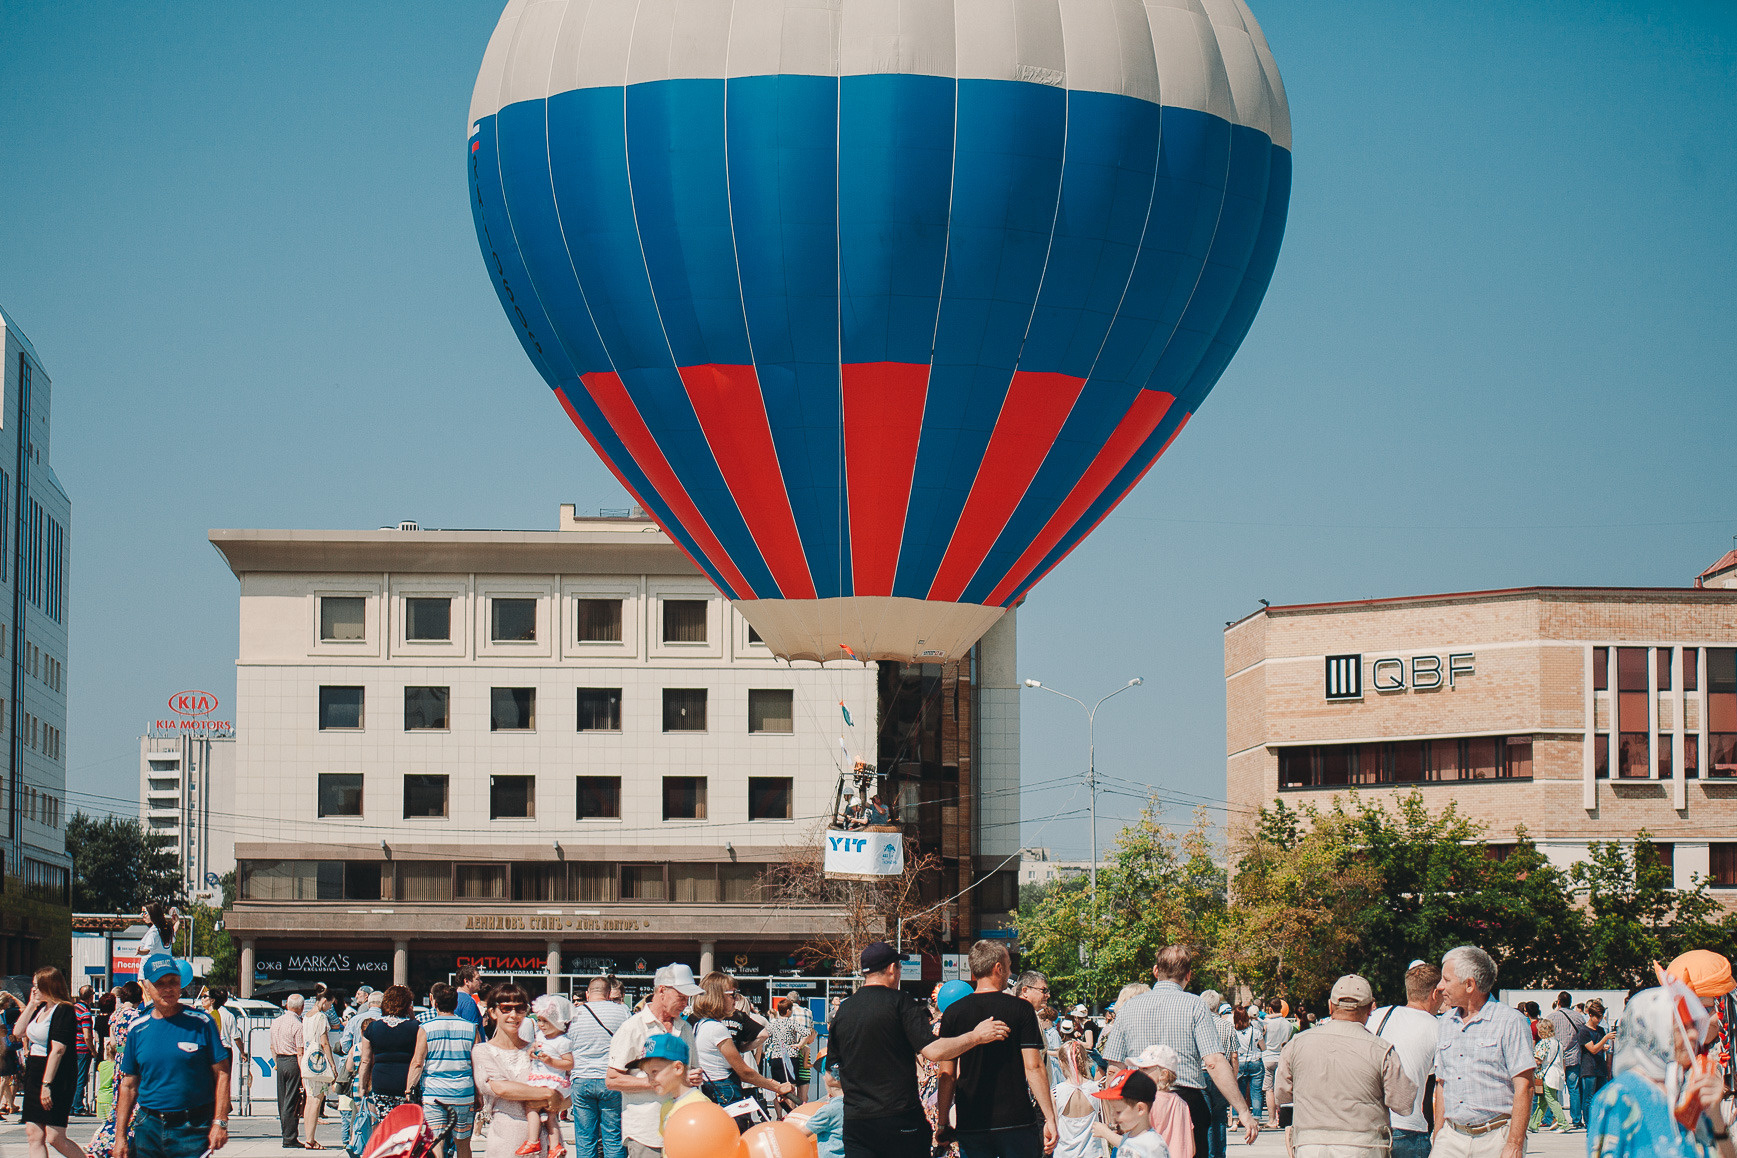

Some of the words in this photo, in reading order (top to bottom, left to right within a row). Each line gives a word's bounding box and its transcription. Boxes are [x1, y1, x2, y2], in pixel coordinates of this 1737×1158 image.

[1373, 652, 1474, 690] QBF
[178, 696, 209, 710] KIA
[156, 720, 176, 729] KIA
[180, 720, 231, 730] MOTORS
[828, 836, 867, 853] YIT
[255, 961, 282, 971] ожа
[288, 953, 350, 969] MARKA'S
[356, 962, 388, 971] меха
[457, 957, 562, 969] СИТИЛИН
